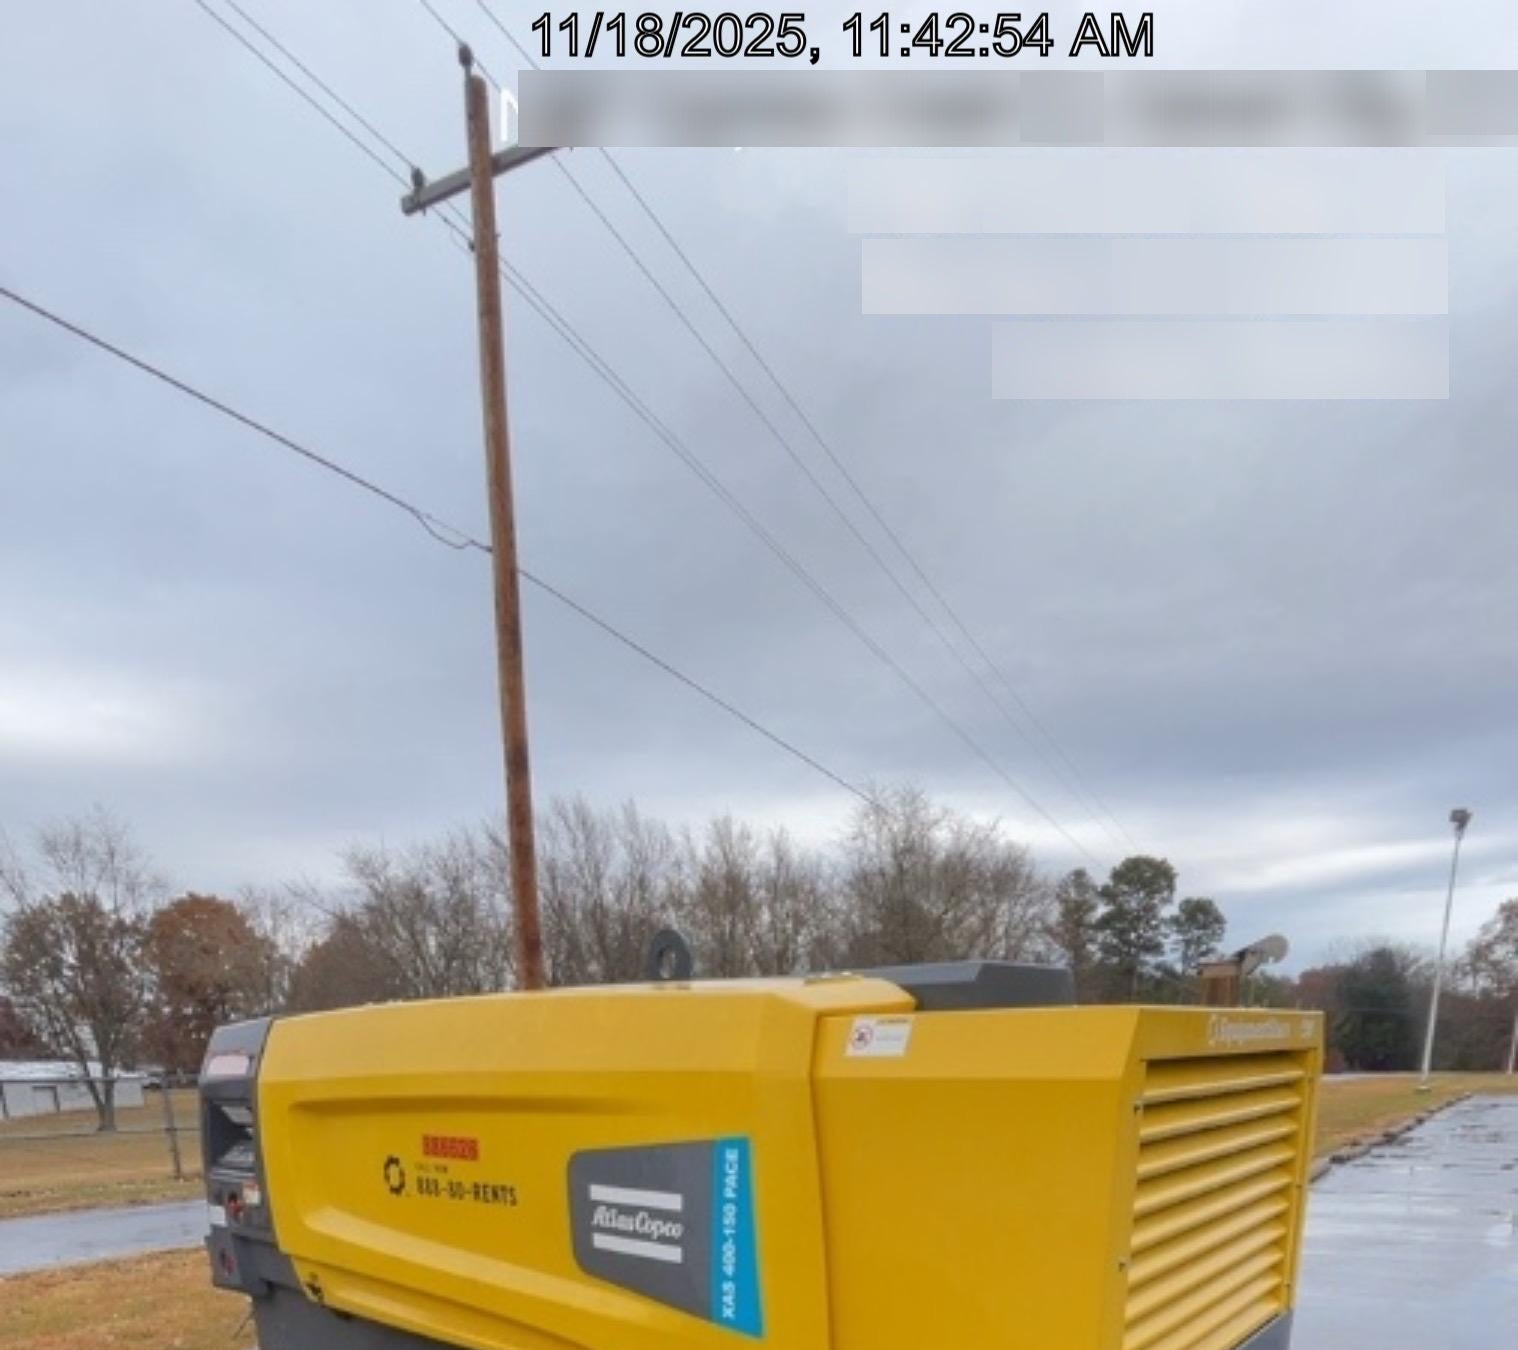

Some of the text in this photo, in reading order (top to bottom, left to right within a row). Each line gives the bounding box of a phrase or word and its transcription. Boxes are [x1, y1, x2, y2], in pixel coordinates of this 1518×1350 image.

[722, 1148, 739, 1319] XAS 400-150 PACE
